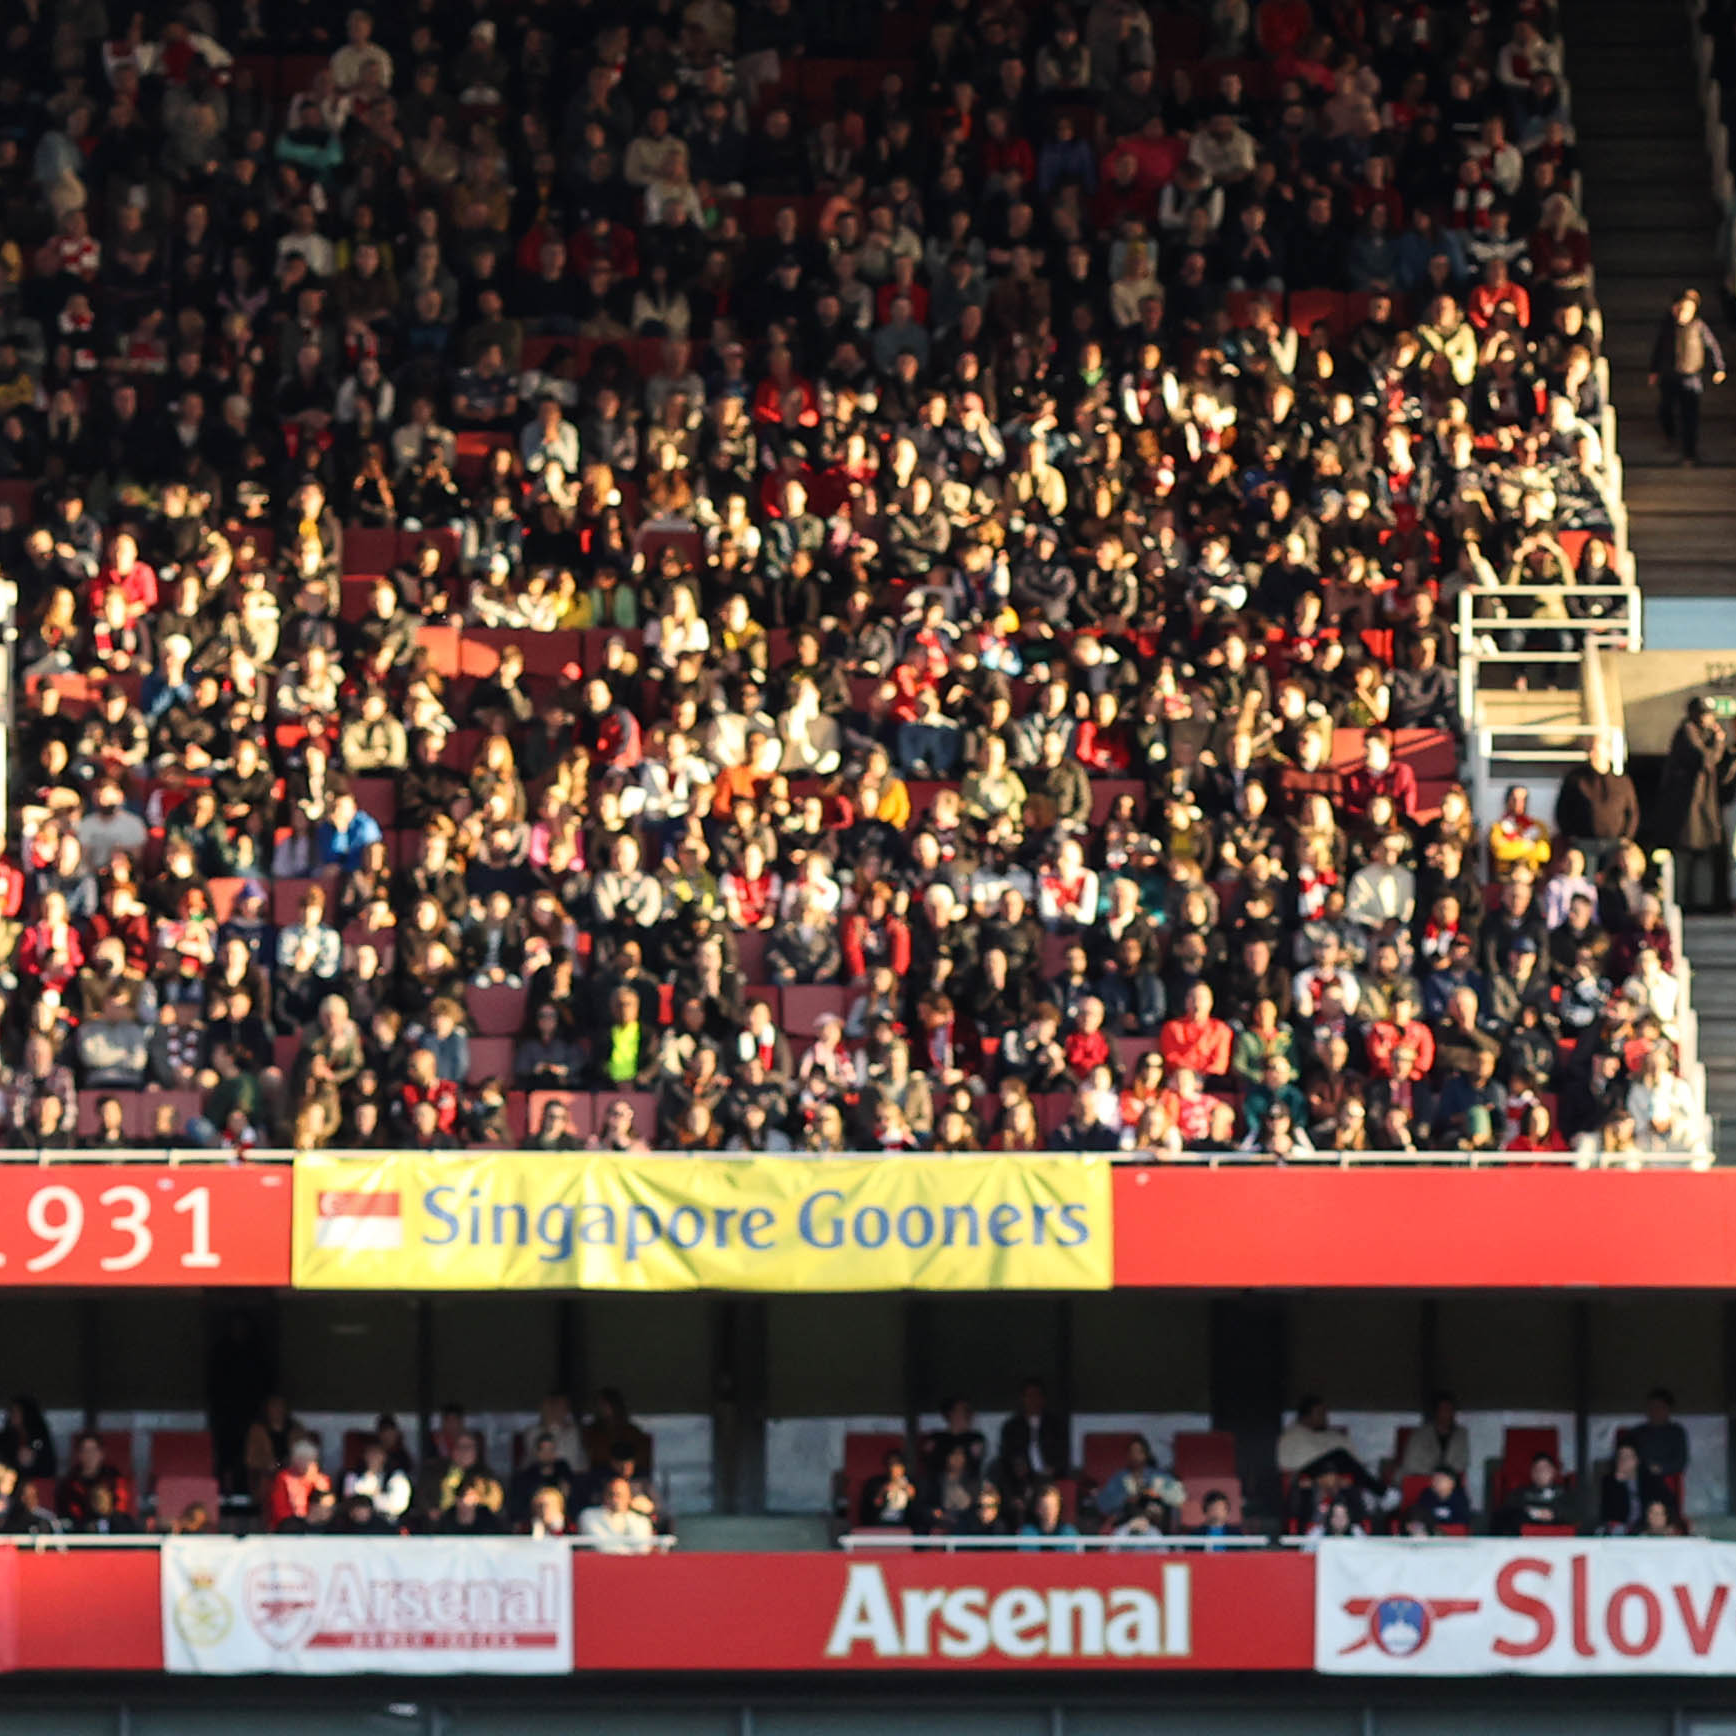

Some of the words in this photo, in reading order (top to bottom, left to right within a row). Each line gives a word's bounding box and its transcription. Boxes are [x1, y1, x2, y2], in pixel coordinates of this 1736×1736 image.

[421, 1185, 777, 1261] Singapore
[798, 1188, 1090, 1250] Gooners
[327, 1561, 562, 1627] Arsenal
[824, 1562, 1192, 1658] Arsenal
